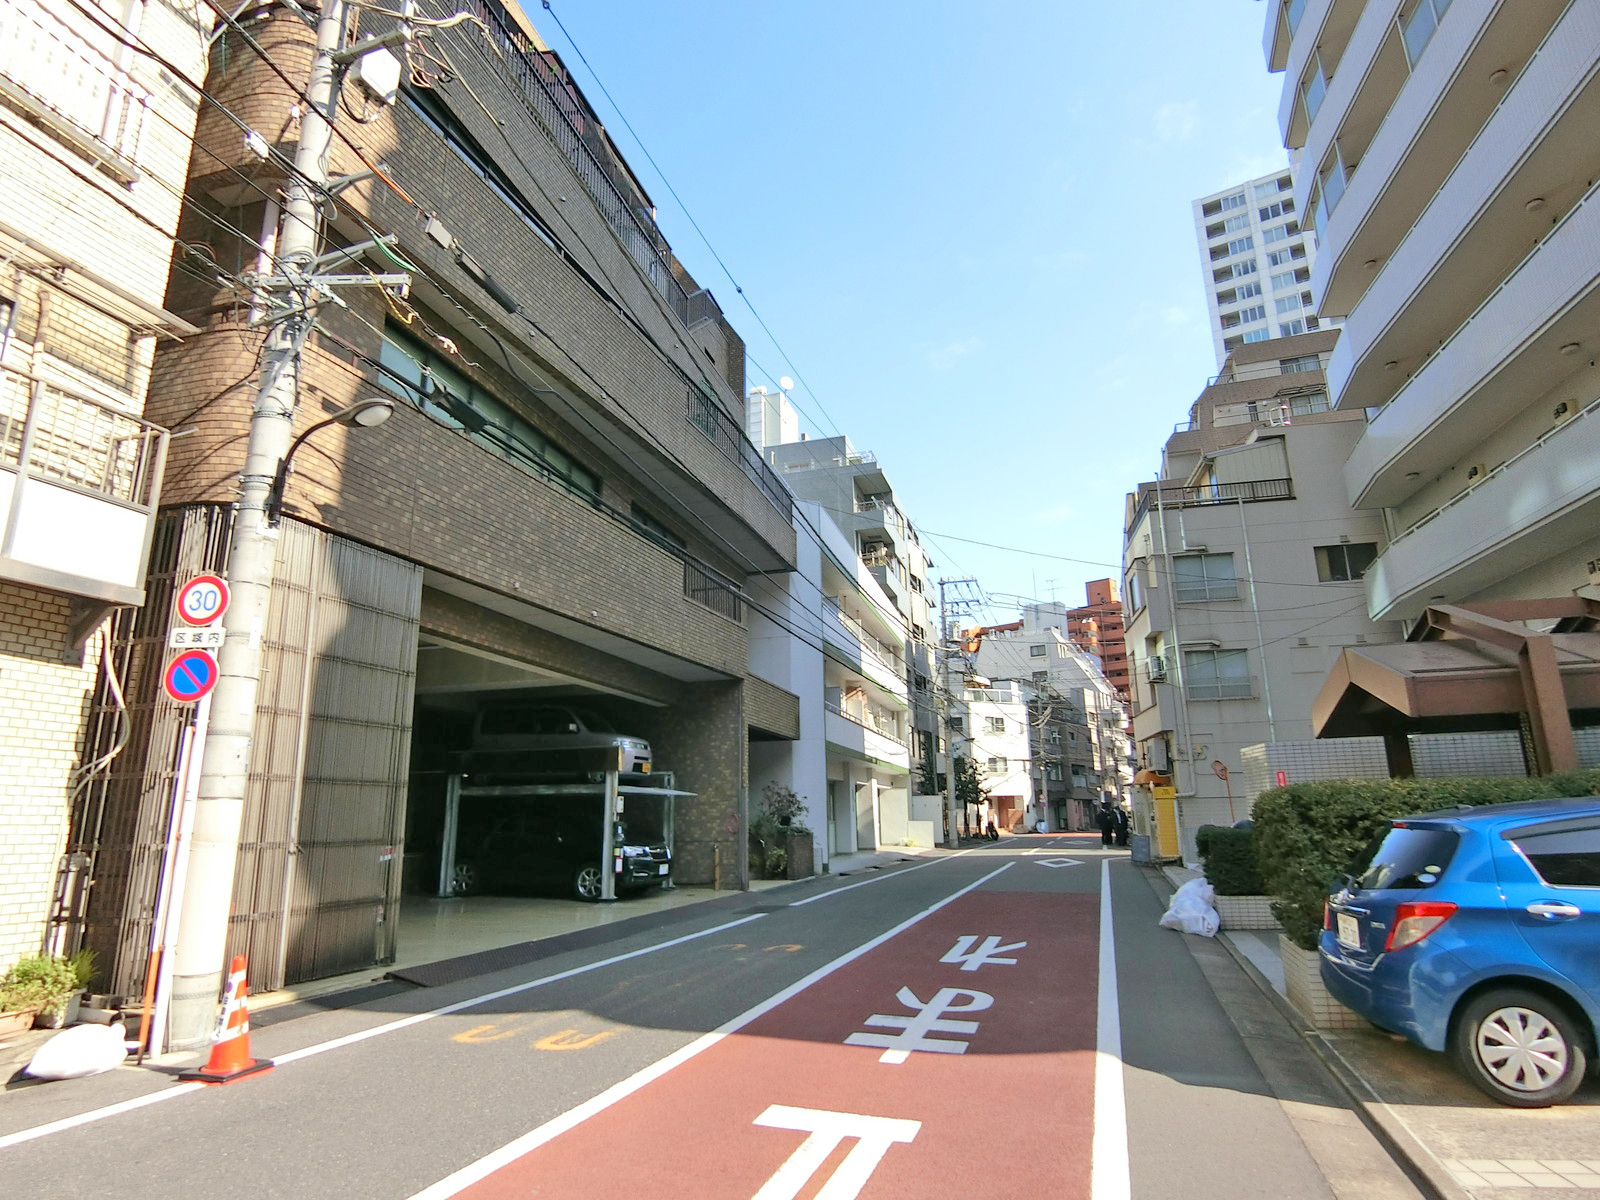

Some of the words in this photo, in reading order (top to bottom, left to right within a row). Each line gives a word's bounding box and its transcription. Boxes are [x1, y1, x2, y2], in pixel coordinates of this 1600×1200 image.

[189, 590, 217, 611] 30
[175, 632, 220, 643] 区域内
